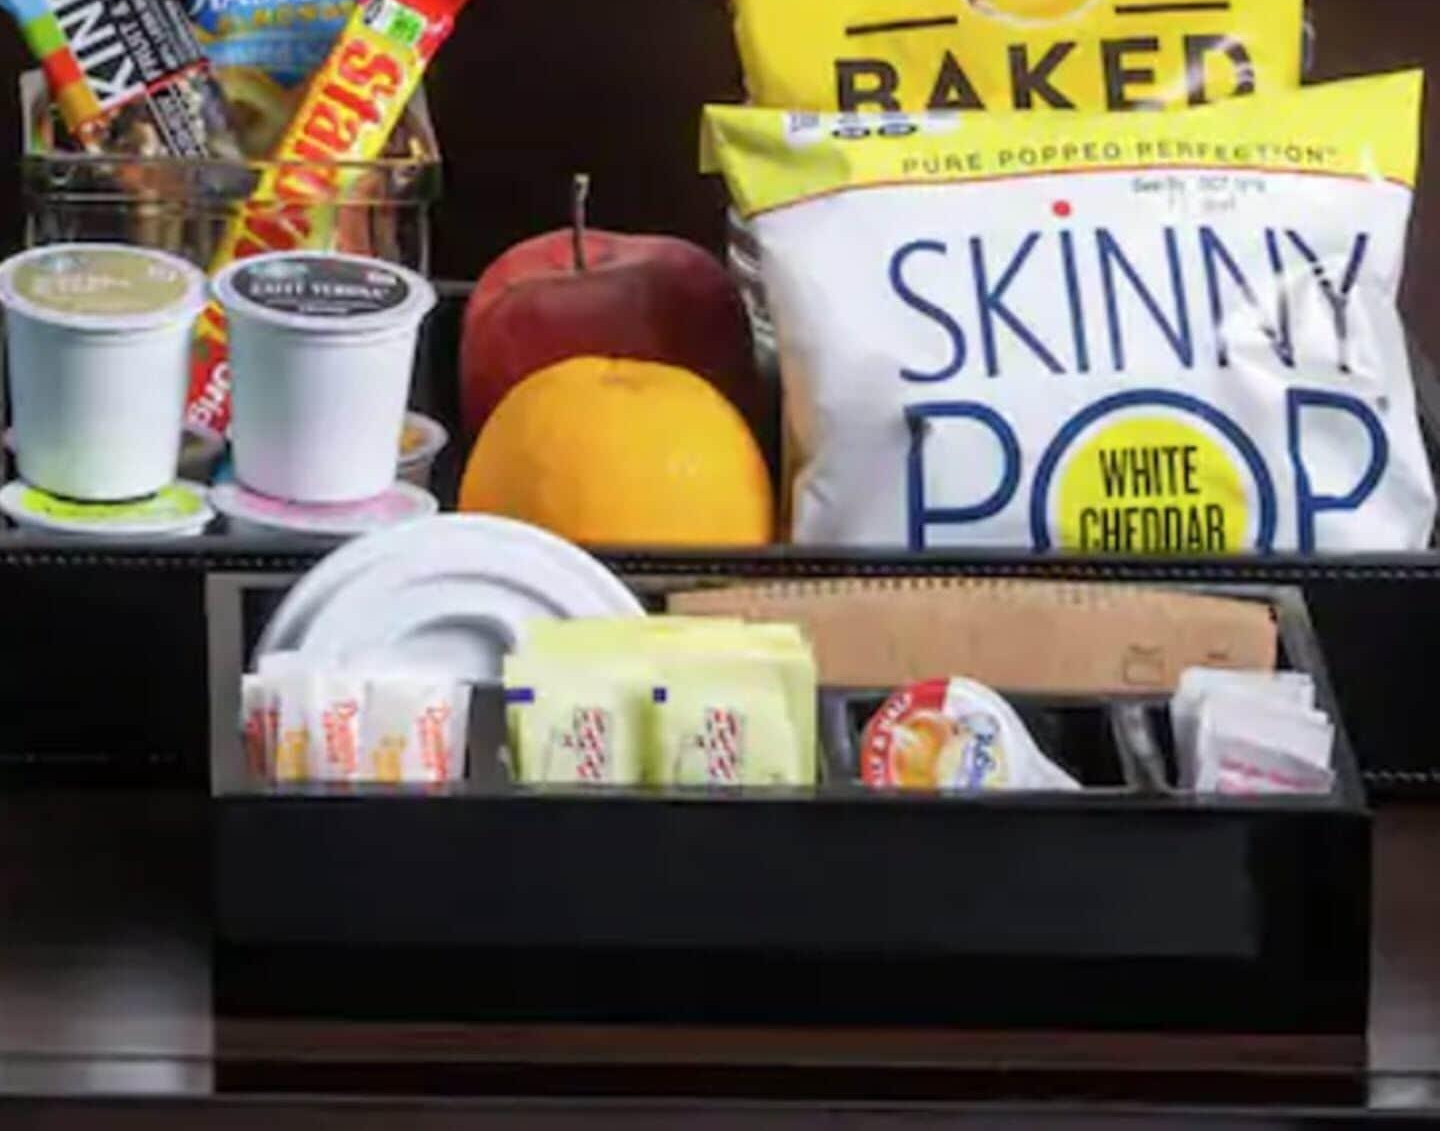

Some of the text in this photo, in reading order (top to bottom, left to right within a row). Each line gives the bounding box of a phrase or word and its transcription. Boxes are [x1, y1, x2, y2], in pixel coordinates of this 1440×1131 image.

[836, 32, 1256, 113] BAKED
[902, 151, 982, 174] PURE
[998, 142, 1122, 167] POPPED
[906, 388, 1391, 551] POP
[1098, 445, 1202, 501] WHITE
[1078, 505, 1226, 551] CHEDDAR
